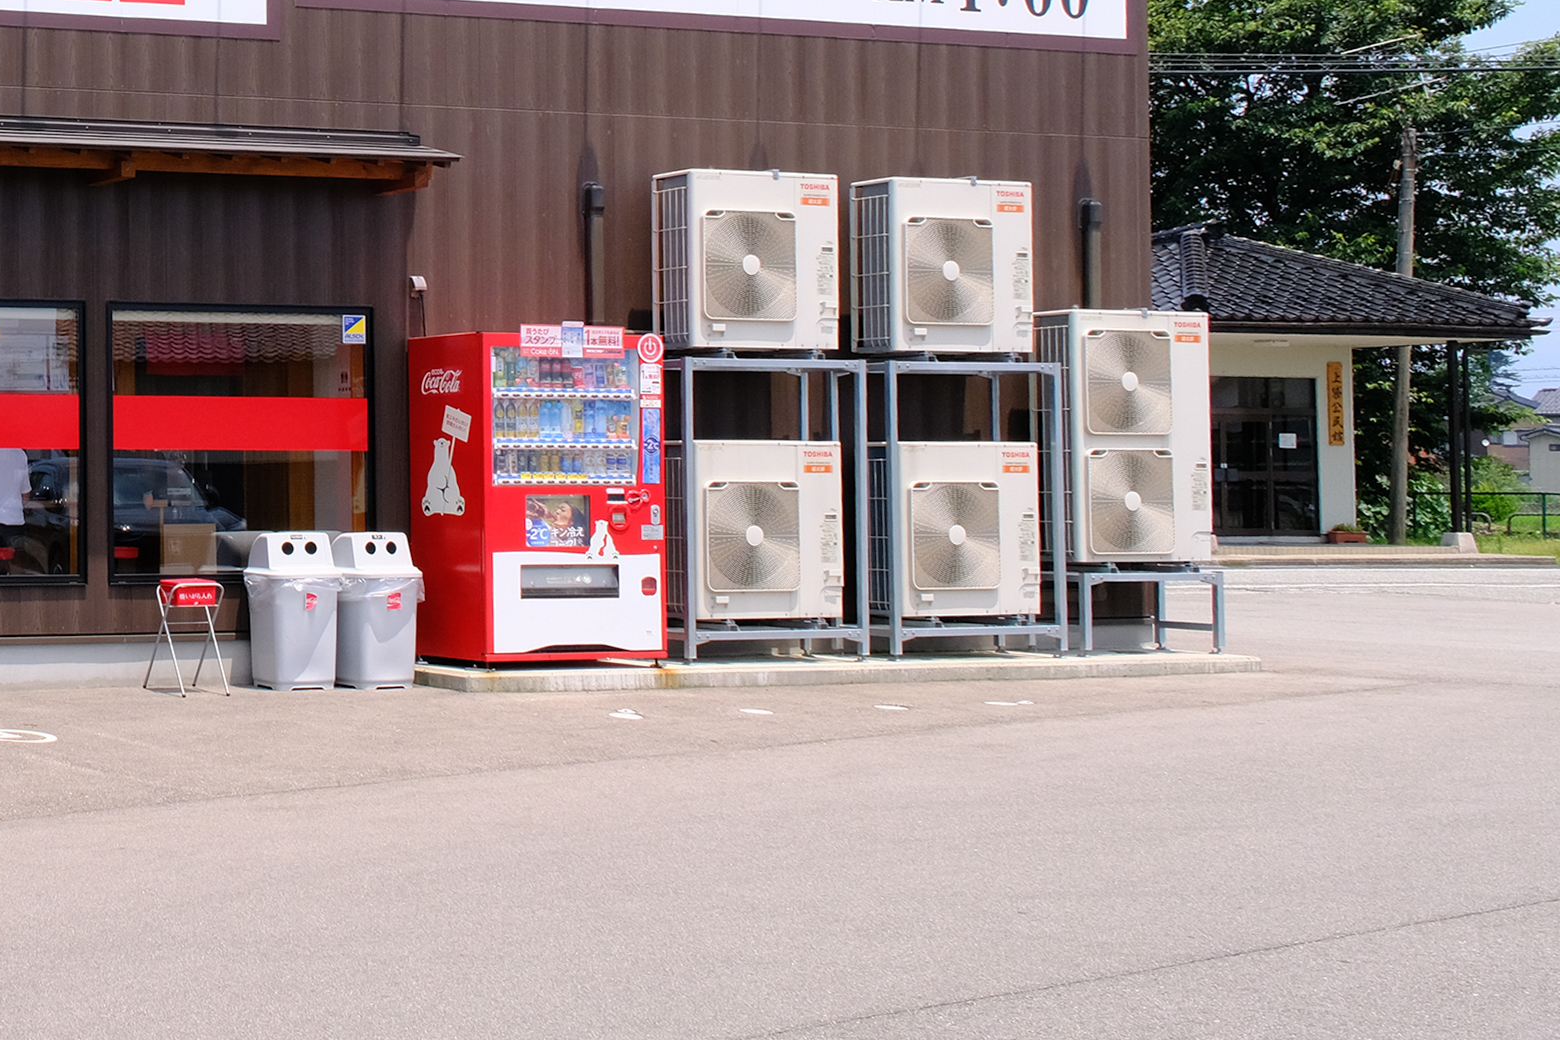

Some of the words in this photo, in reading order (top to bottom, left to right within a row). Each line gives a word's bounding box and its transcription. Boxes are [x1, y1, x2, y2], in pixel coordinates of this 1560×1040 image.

[800, 183, 830, 191] TOSHIBA
[996, 190, 1025, 198] TOSHIBA
[1173, 321, 1201, 329] TOSHIBA
[525, 335, 557, 345] スタンプ
[421, 370, 463, 395] Coca-Cola
